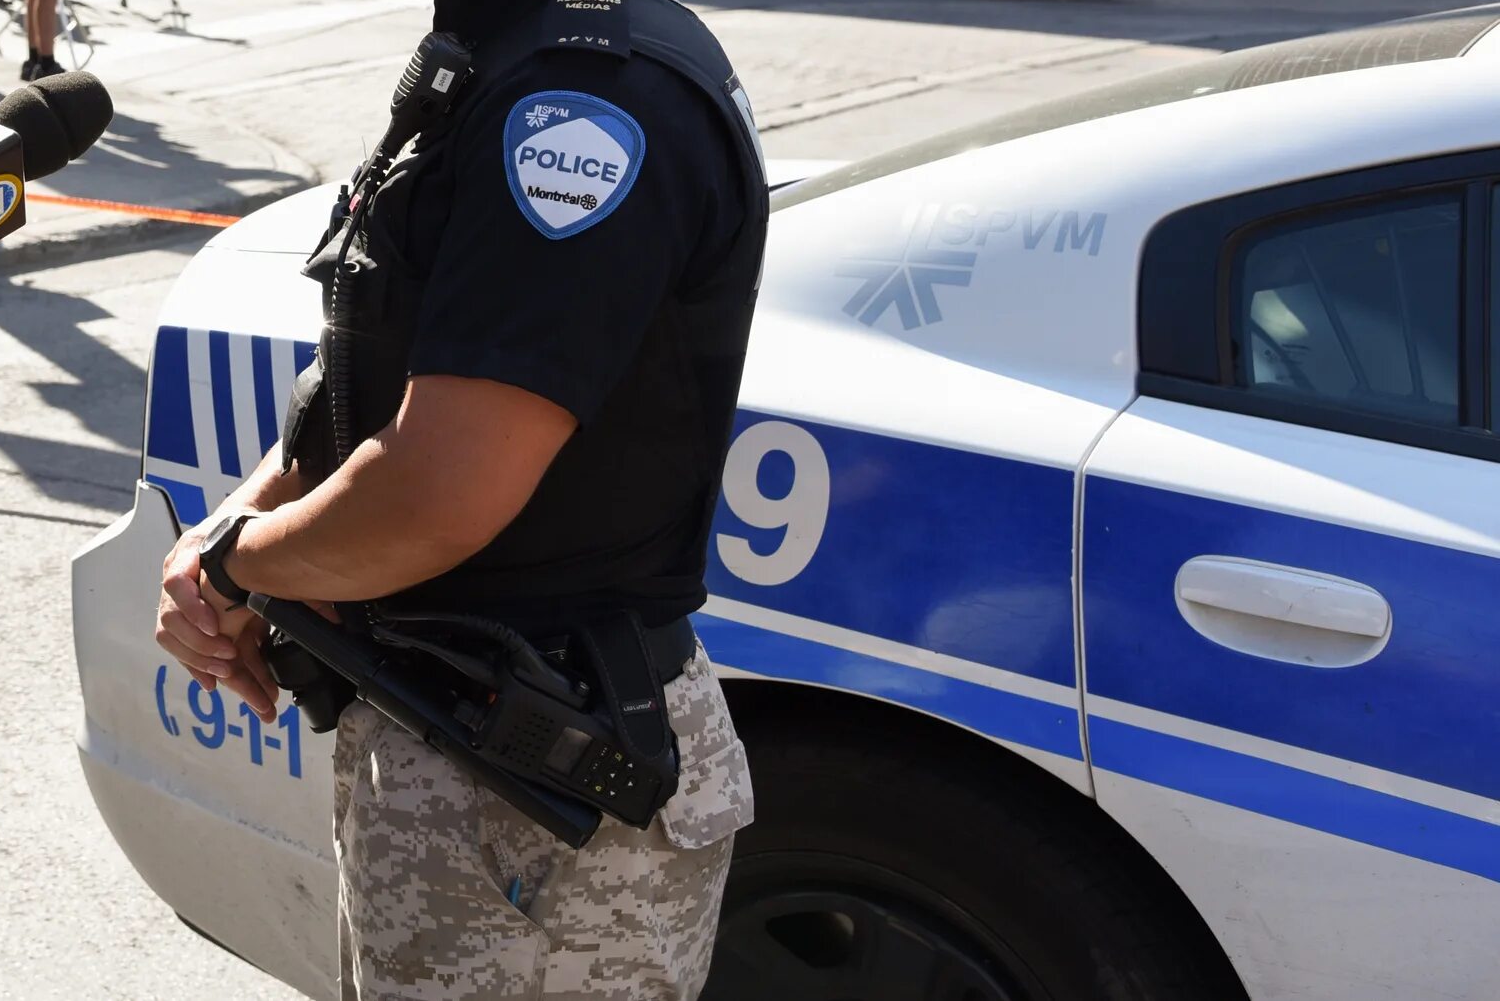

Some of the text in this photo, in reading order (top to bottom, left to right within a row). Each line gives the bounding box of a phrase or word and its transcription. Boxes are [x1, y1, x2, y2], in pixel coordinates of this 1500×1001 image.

[565, 1, 610, 11] MÉDIAS
[541, 105, 569, 118] SPVM
[519, 146, 619, 184] POLICE
[527, 185, 580, 206] Montréal
[941, 203, 1108, 257] SPVM
[716, 420, 830, 586] 9
[187, 679, 302, 779] 9-1-1
